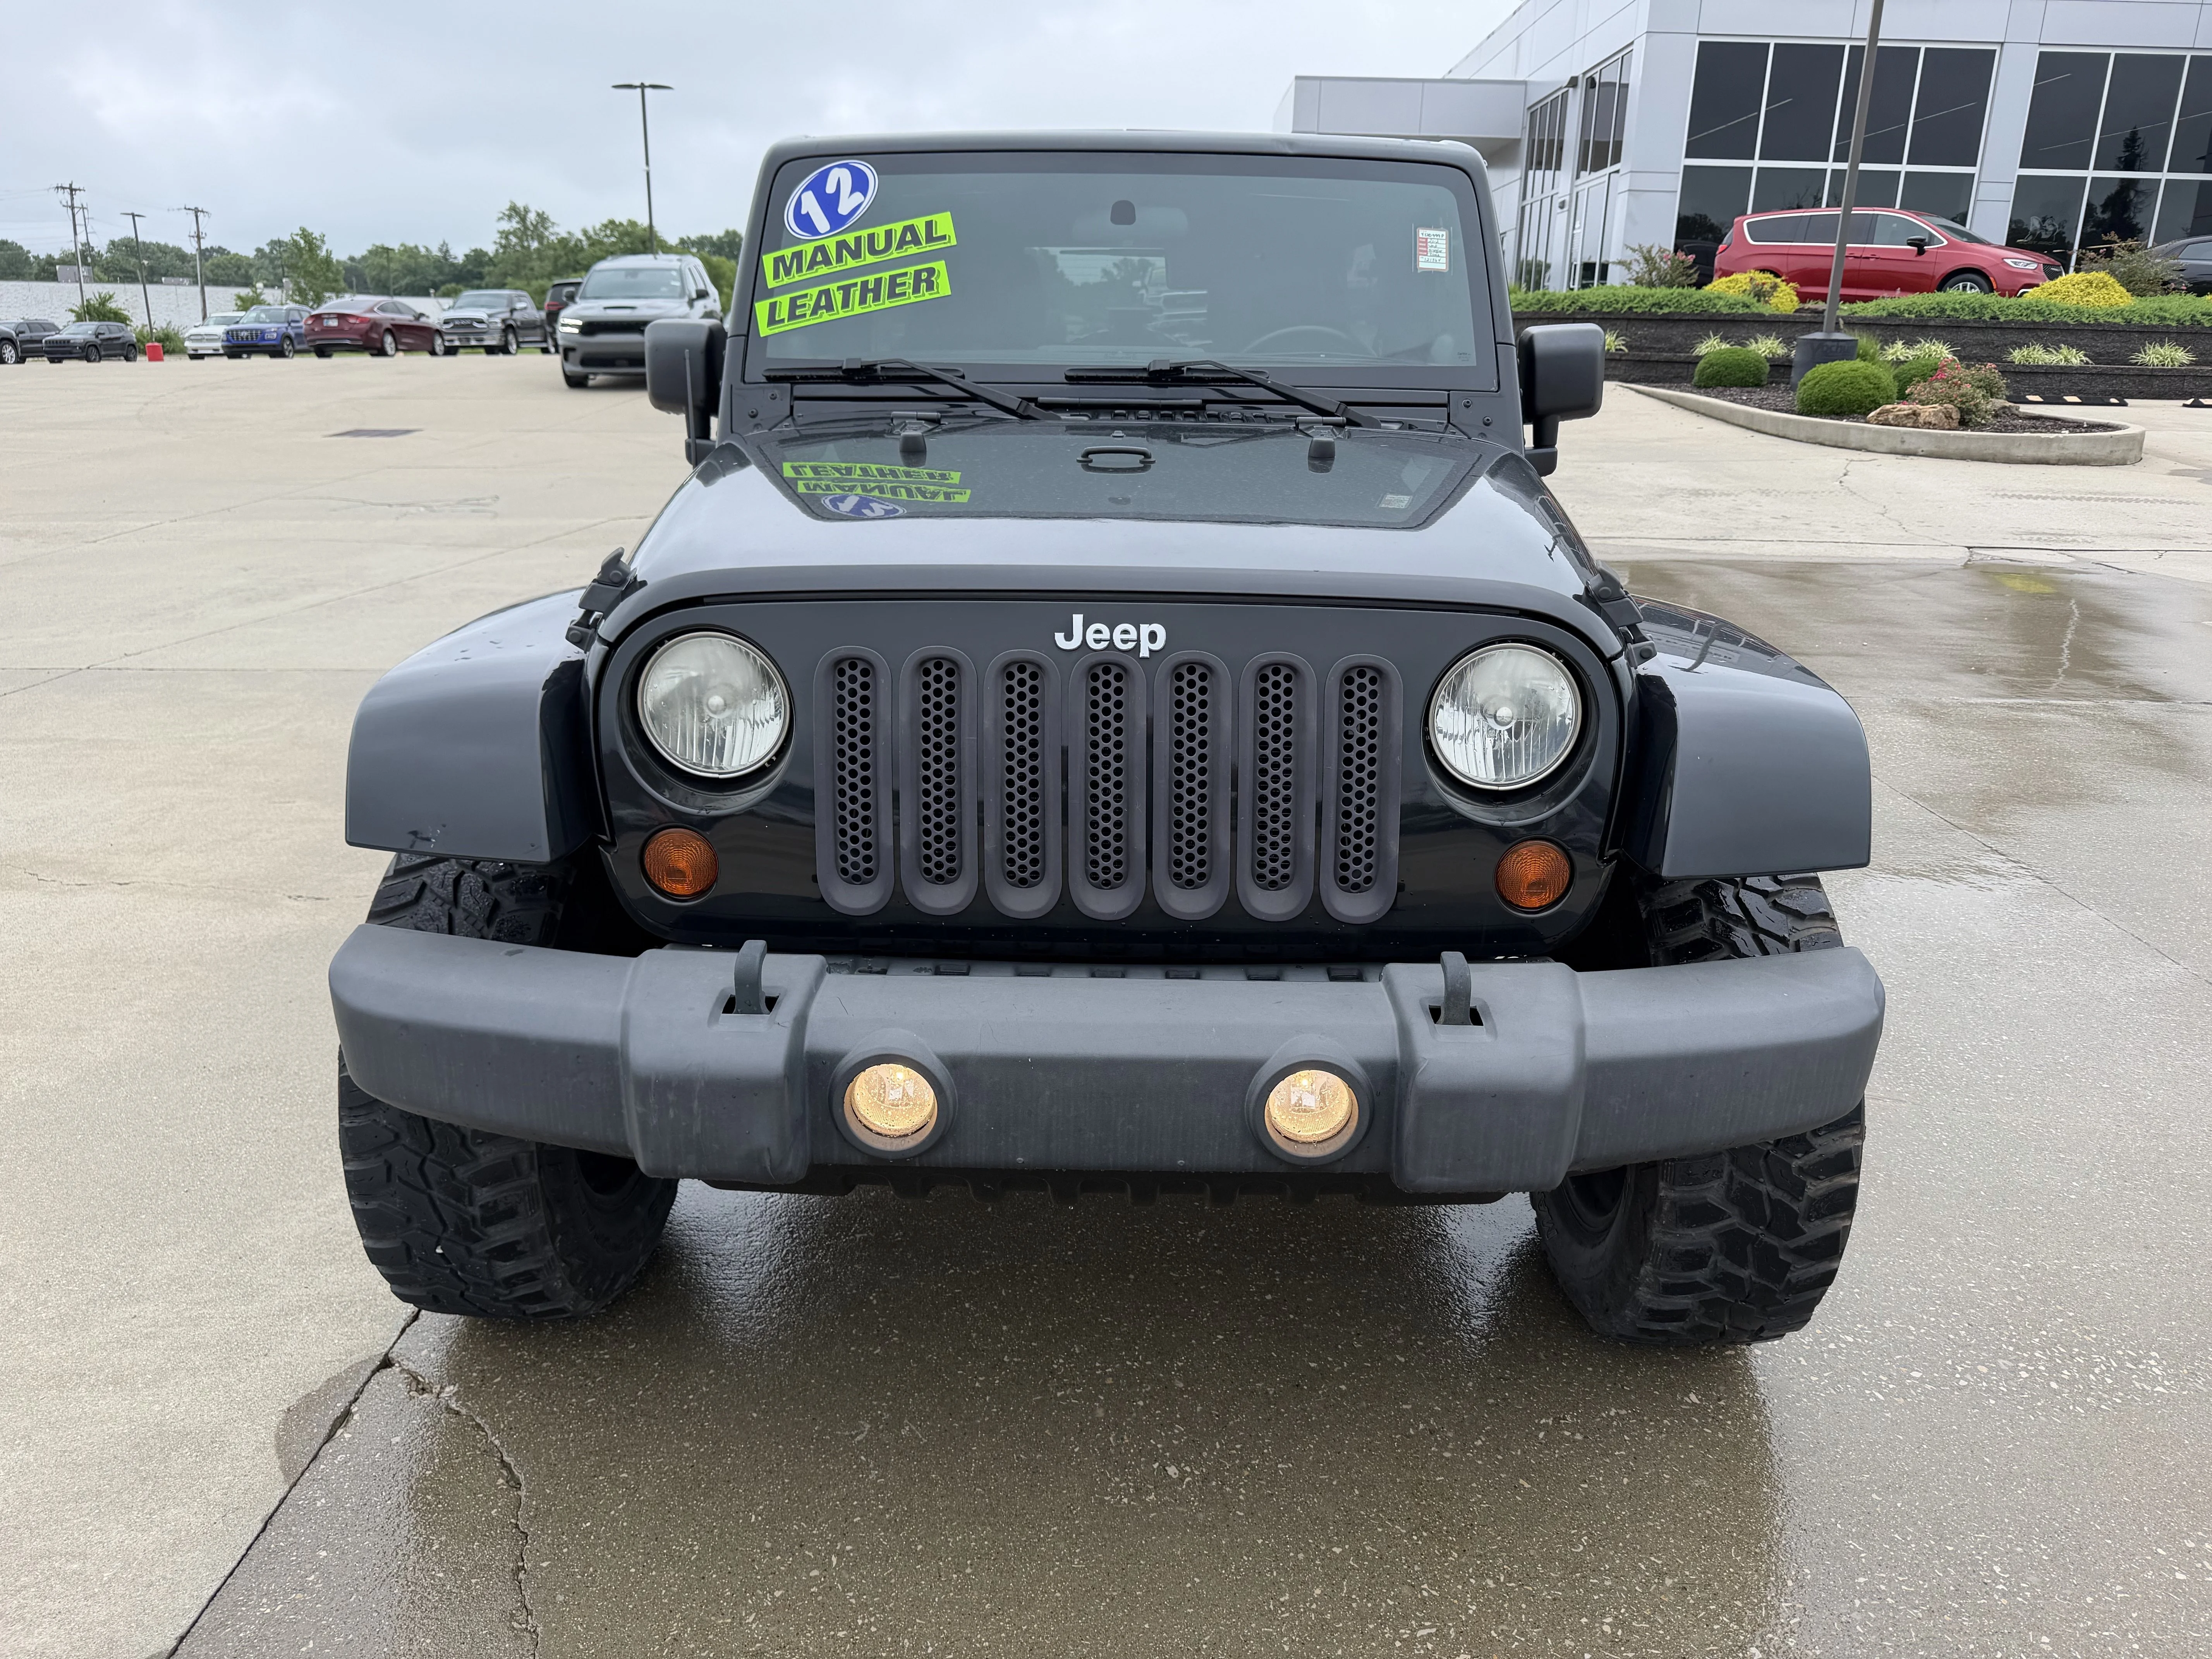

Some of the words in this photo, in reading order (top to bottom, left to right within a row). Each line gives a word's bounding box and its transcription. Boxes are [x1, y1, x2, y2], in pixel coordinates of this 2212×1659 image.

[801, 167, 865, 234] 12
[773, 219, 951, 283] MANUAL
[767, 266, 941, 331] LEATHER
[1054, 614, 1166, 658] Jeep
